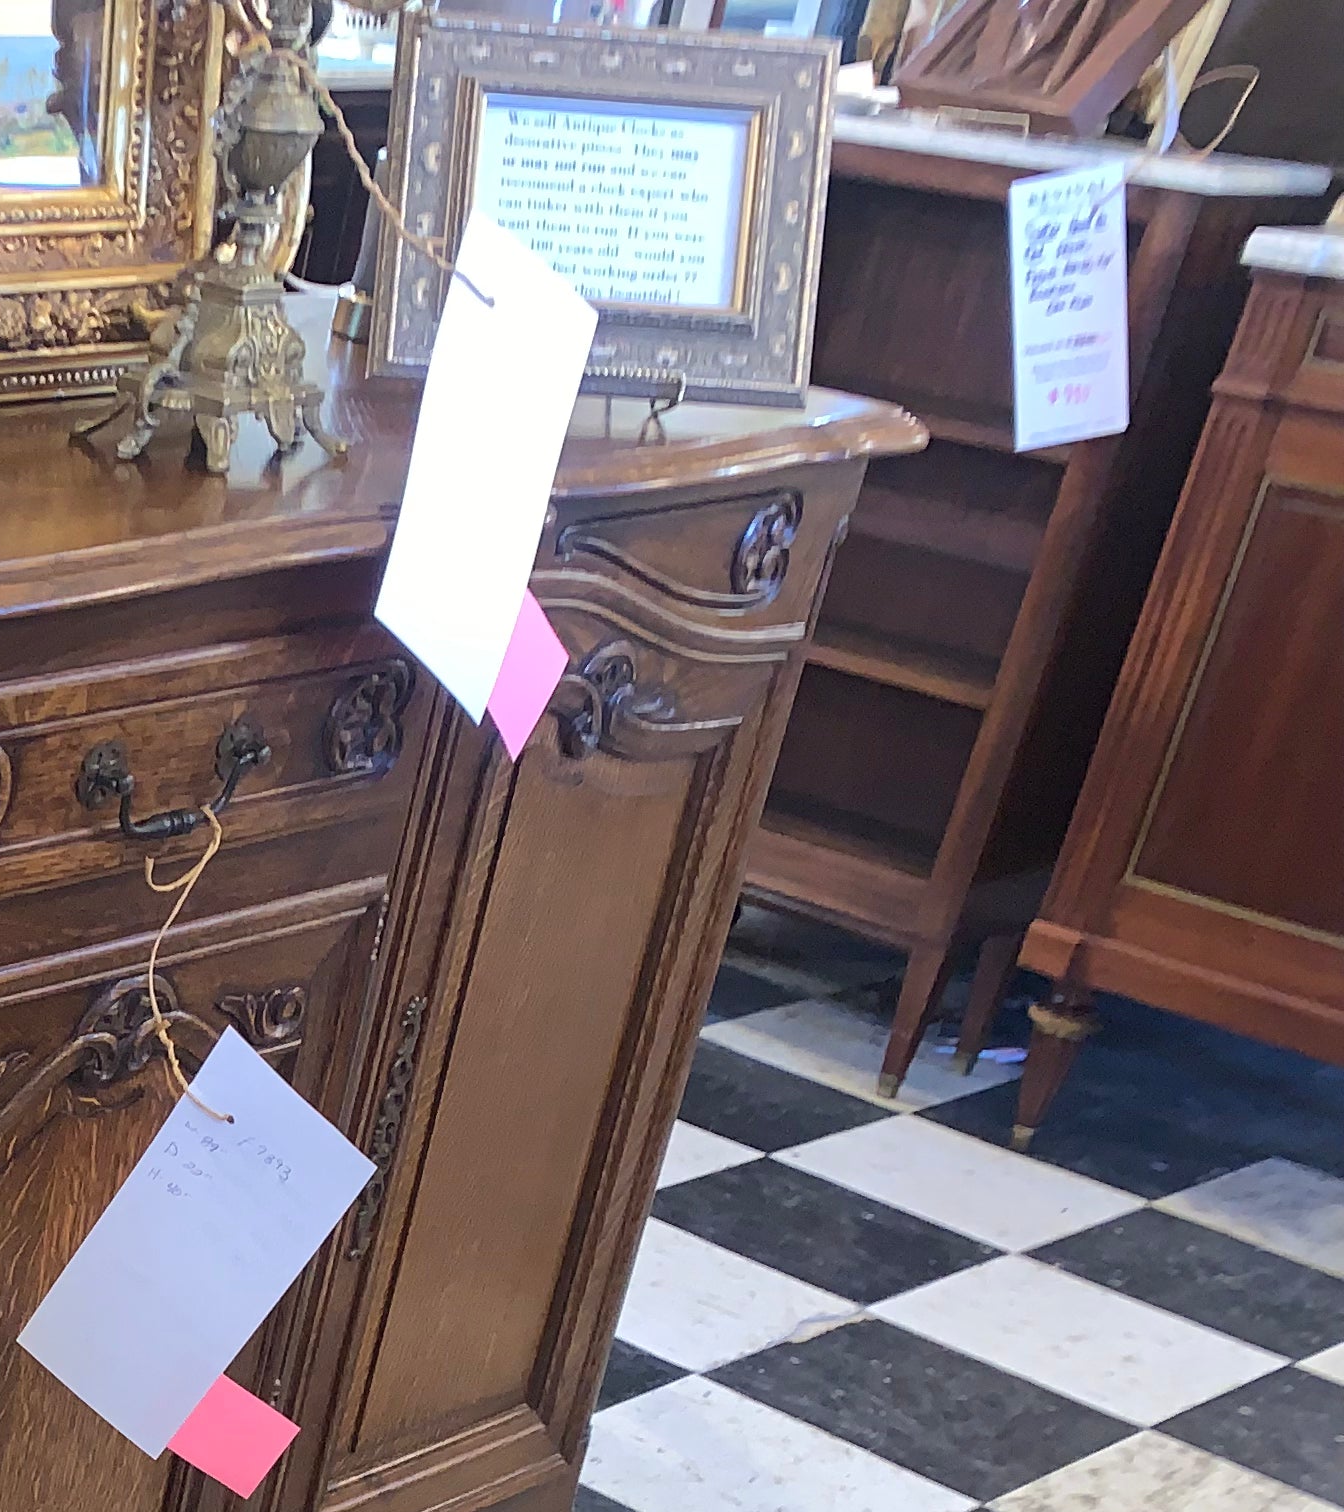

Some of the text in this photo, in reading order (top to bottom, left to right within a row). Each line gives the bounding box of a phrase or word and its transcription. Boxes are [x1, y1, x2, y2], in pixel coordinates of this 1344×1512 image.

[508, 111, 530, 127] We
[534, 112, 556, 130] sell
[563, 115, 616, 136] Antique
[621, 118, 665, 137] Clocks
[504, 133, 576, 150] decorative
[634, 143, 663, 158] They
[671, 148, 699, 161] may
[521, 156, 548, 170] may
[555, 160, 576, 173] not
[581, 162, 606, 174] run
[610, 163, 636, 176] and
[662, 170, 687, 180] can
[501, 176, 574, 193] recommend
[591, 182, 625, 196] clock
[631, 188, 674, 203] expert
[681, 188, 709, 203] who
[498, 198, 688, 222] can tinker with them if you
[497, 218, 530, 230] want
[536, 219, 570, 233] them
[576, 223, 590, 234] to
[644, 231, 668, 241] you
[675, 232, 705, 243] were
[558, 242, 593, 255] years
[634, 248, 675, 263] would
[680, 254, 705, 264] you
[583, 264, 638, 282] working
[610, 284, 671, 304] beautiful
